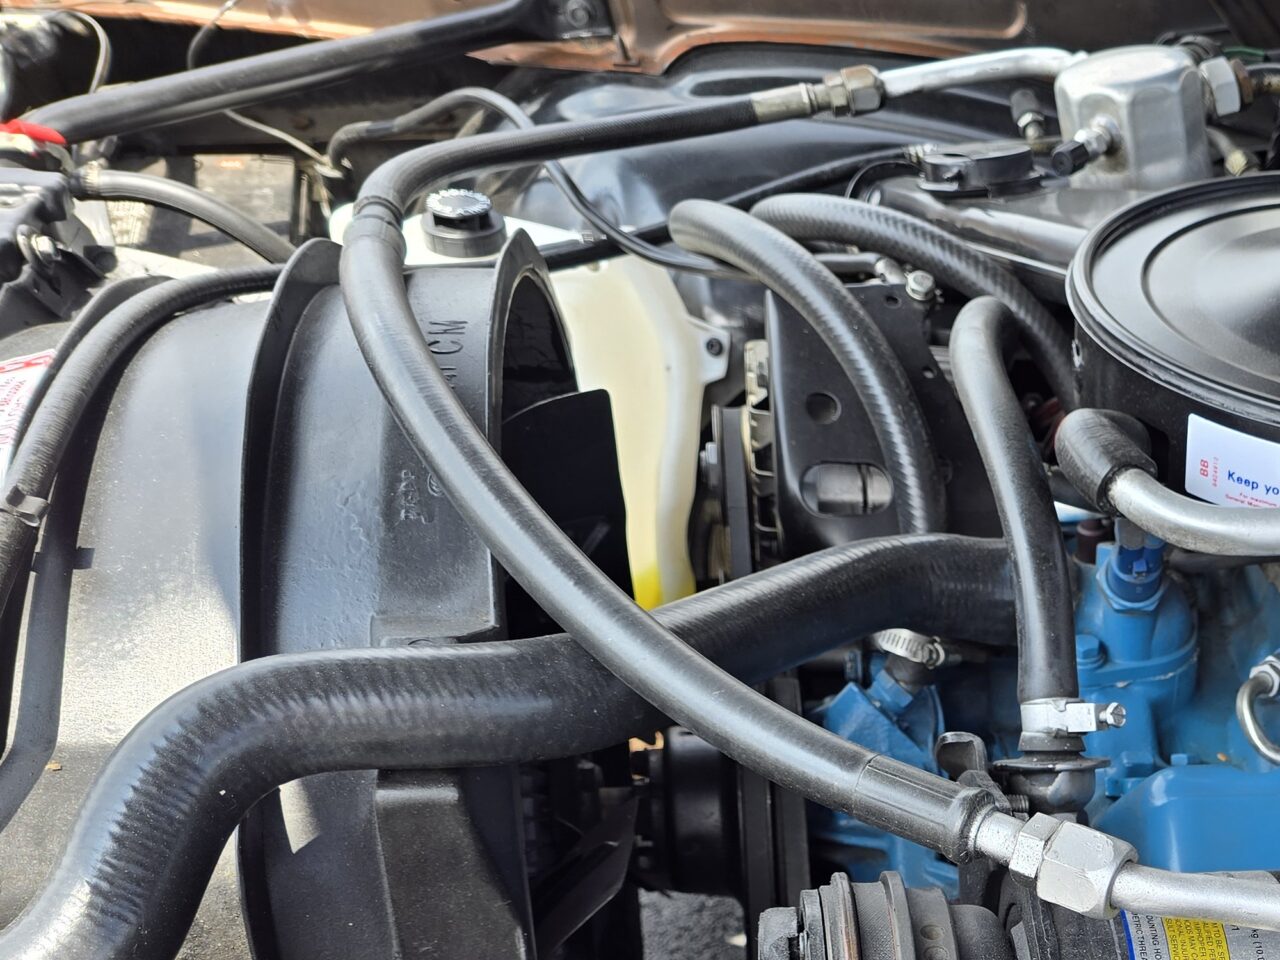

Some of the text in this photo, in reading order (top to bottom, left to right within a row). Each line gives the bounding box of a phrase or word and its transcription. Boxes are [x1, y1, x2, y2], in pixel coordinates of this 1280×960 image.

[1227, 469, 1259, 490] Keep
[1131, 913, 1144, 935] ETRIC
[1188, 935, 1198, 951] MAY
[1215, 940, 1225, 951] BE
